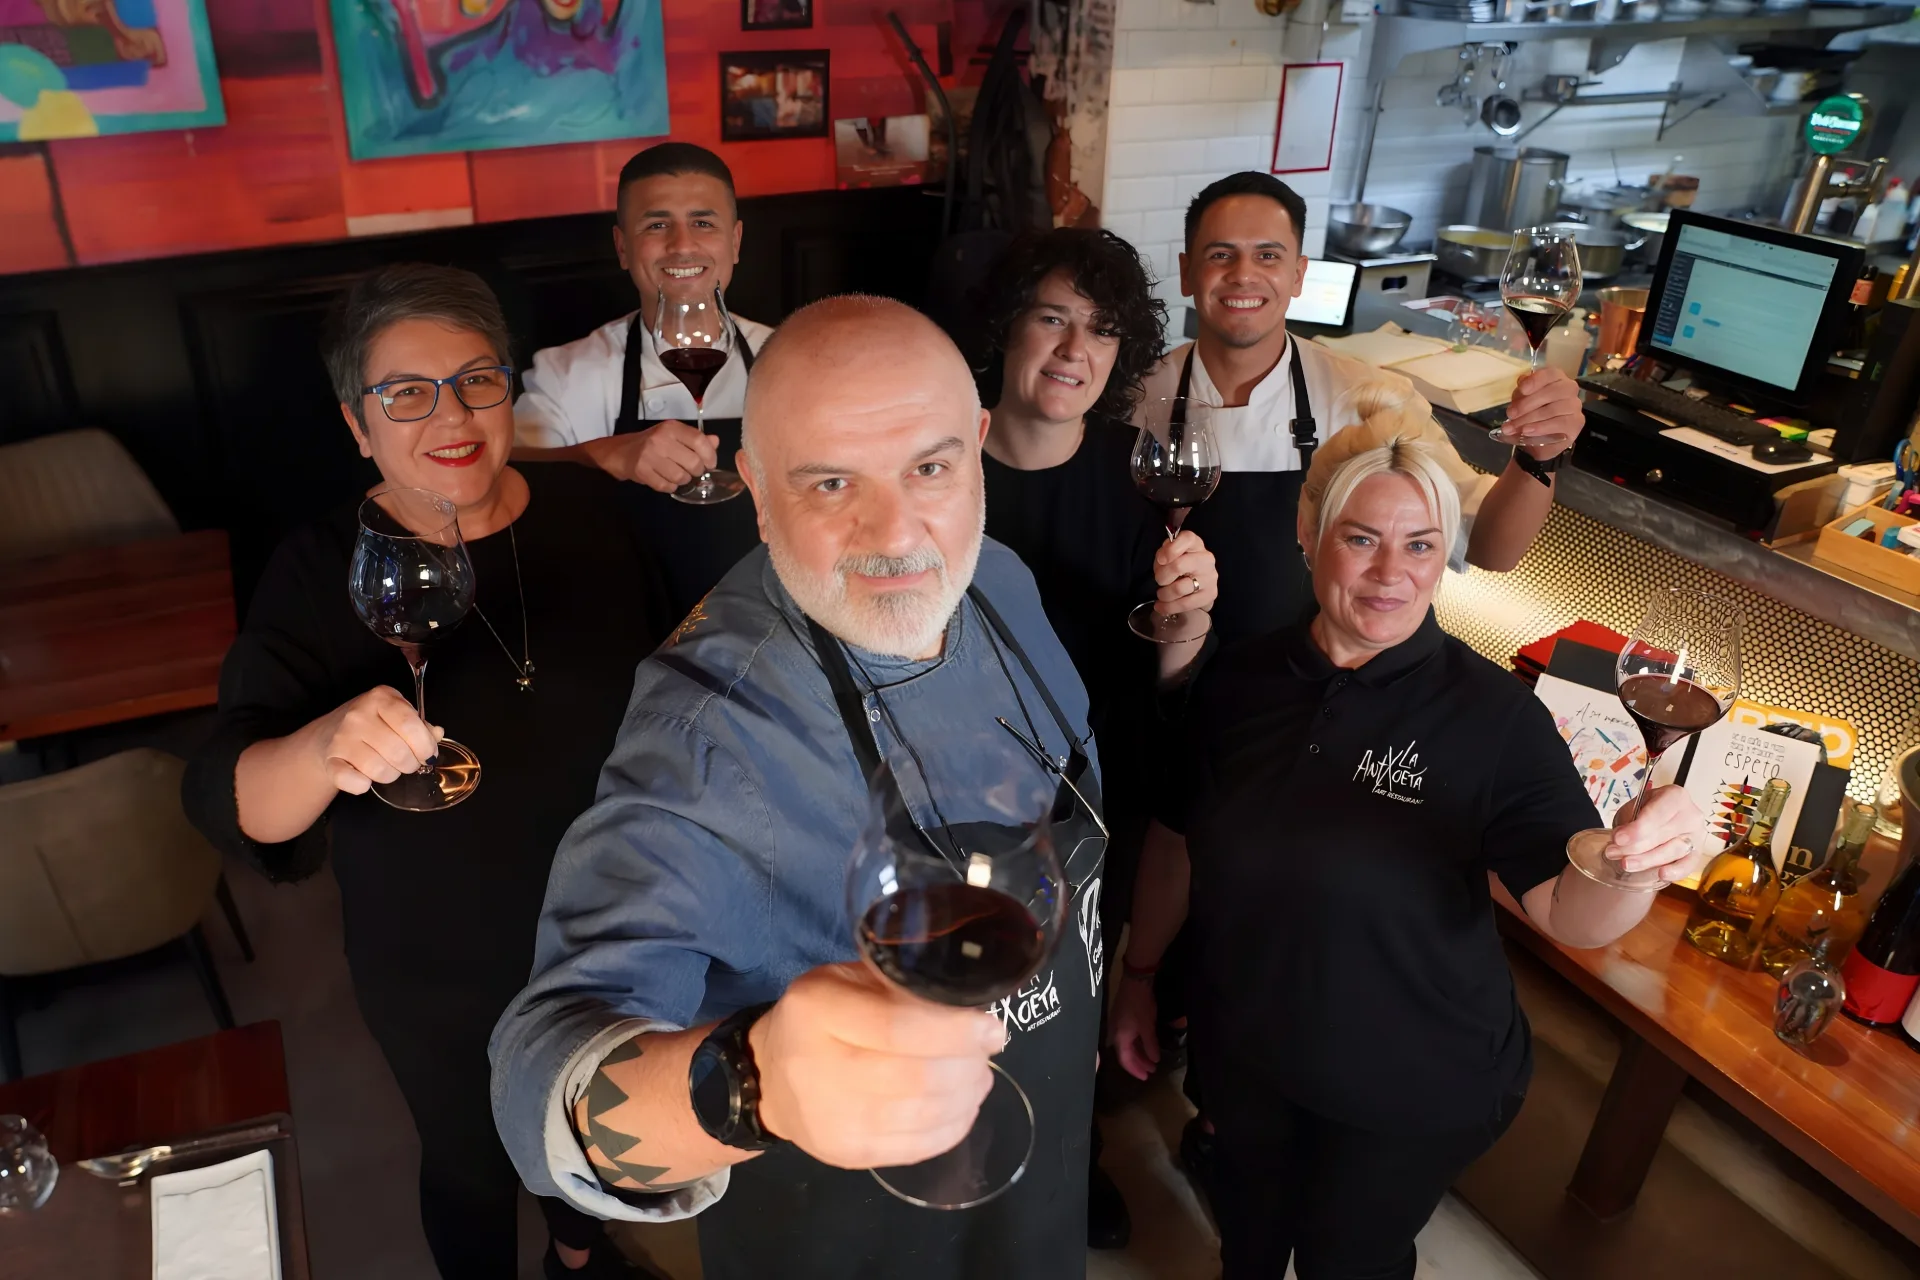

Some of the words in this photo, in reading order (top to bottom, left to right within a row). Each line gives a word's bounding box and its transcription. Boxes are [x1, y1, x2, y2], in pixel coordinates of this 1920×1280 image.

[1399, 740, 1418, 769] LA
[1724, 751, 1780, 779] espeto
[1375, 788, 1388, 796] ART
[1387, 792, 1424, 805] RESTAURANT
